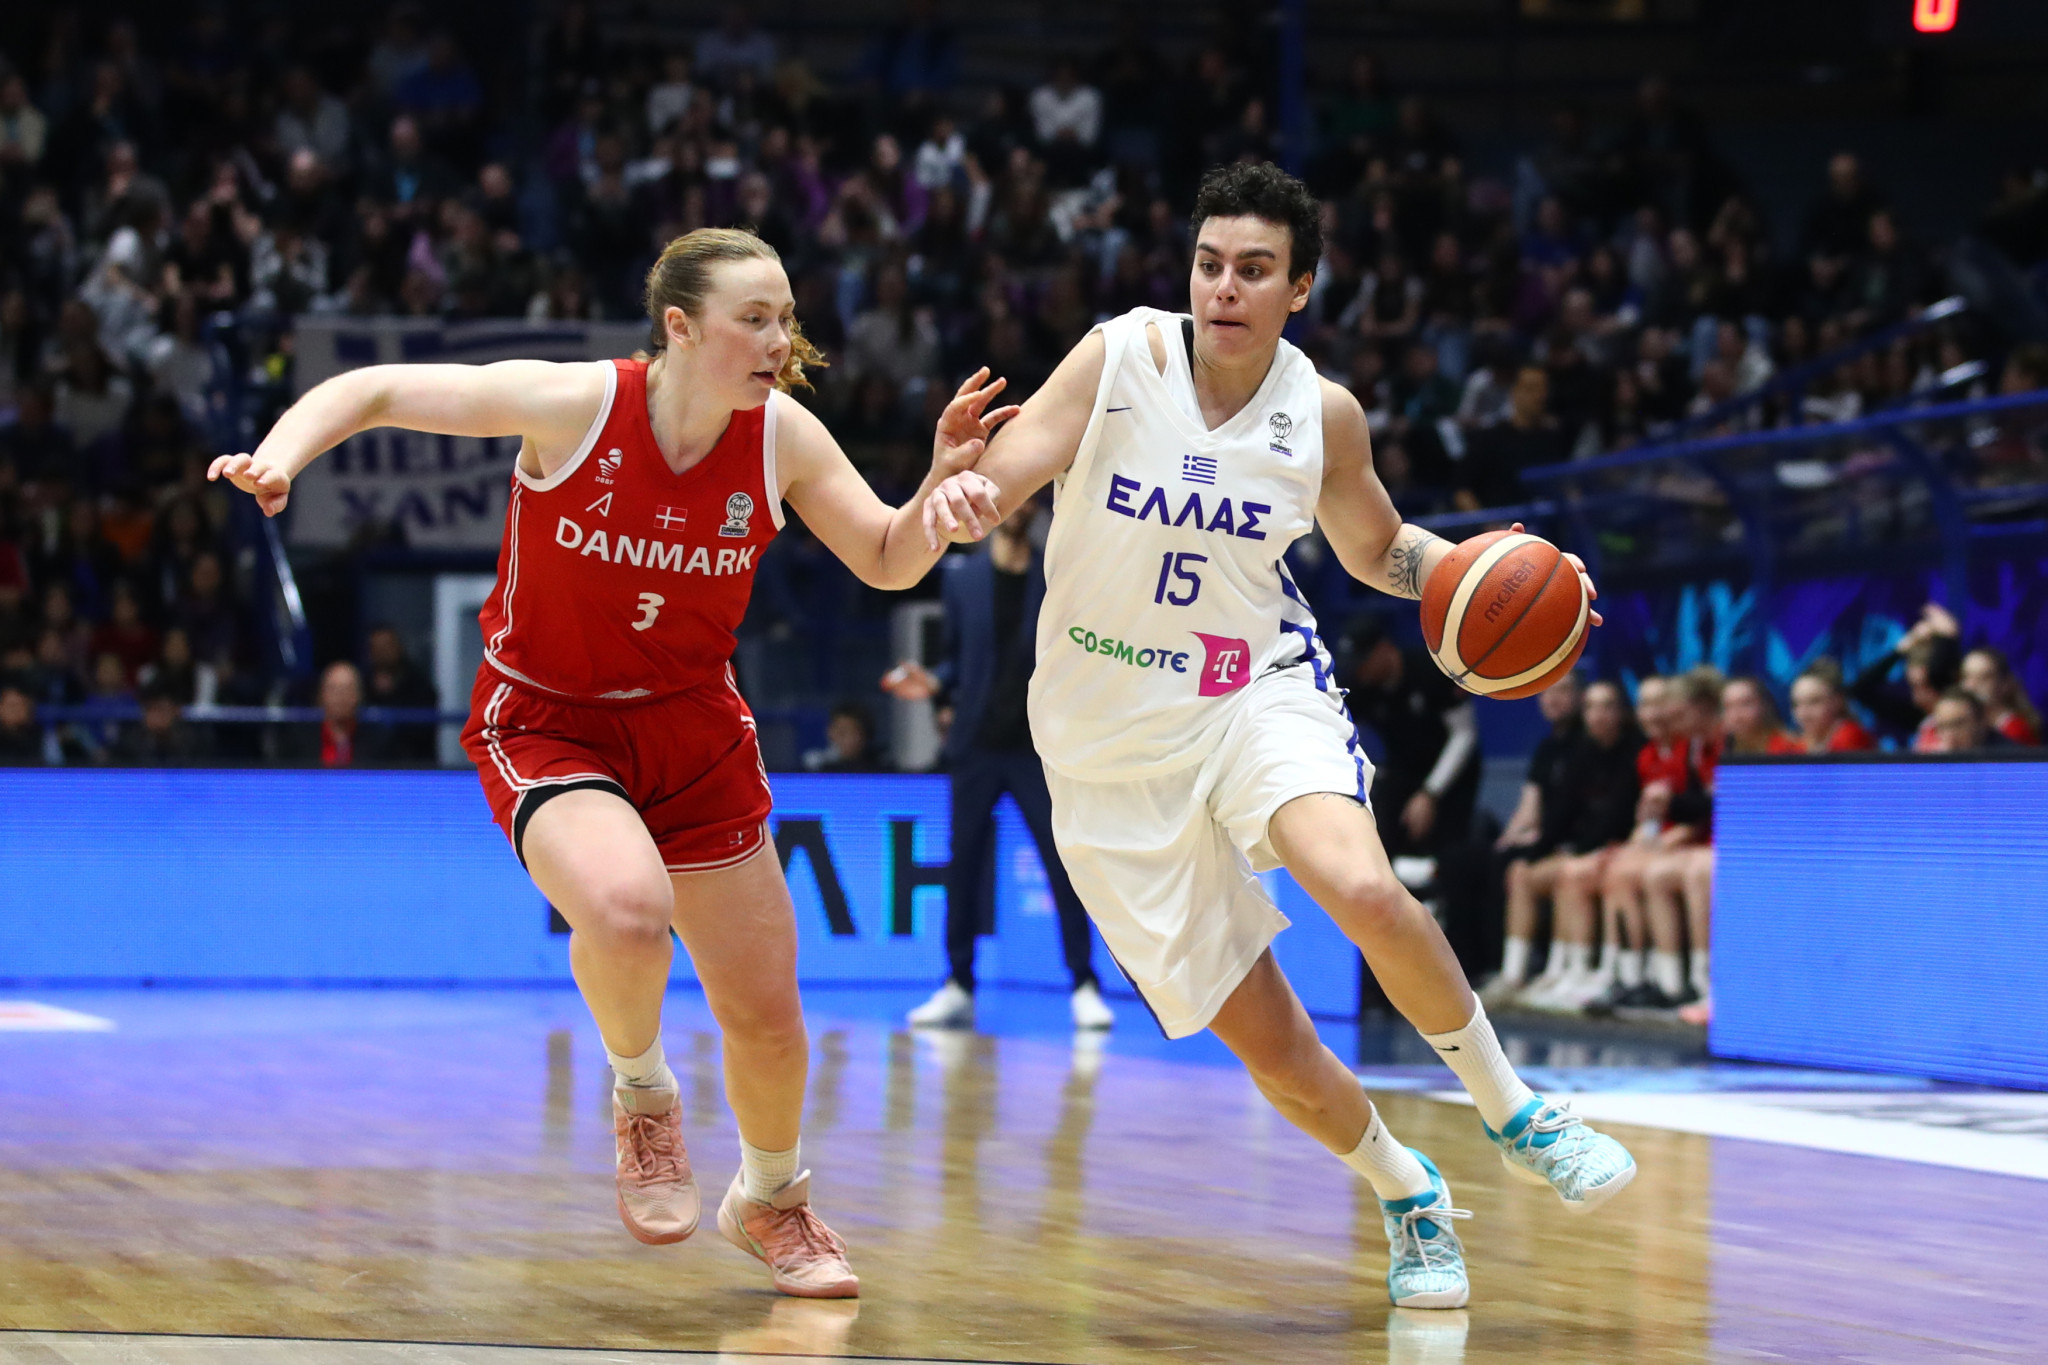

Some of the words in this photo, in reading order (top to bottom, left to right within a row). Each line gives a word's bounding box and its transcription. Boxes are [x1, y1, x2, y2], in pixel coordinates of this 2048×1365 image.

[1106, 473, 1271, 540] ΕΛΛΑΣ
[555, 515, 756, 576] DANMARK
[1154, 551, 1208, 606] 15
[1484, 560, 1536, 623] molten
[631, 592, 665, 631] 3
[1068, 626, 1190, 673] COSMOTE
